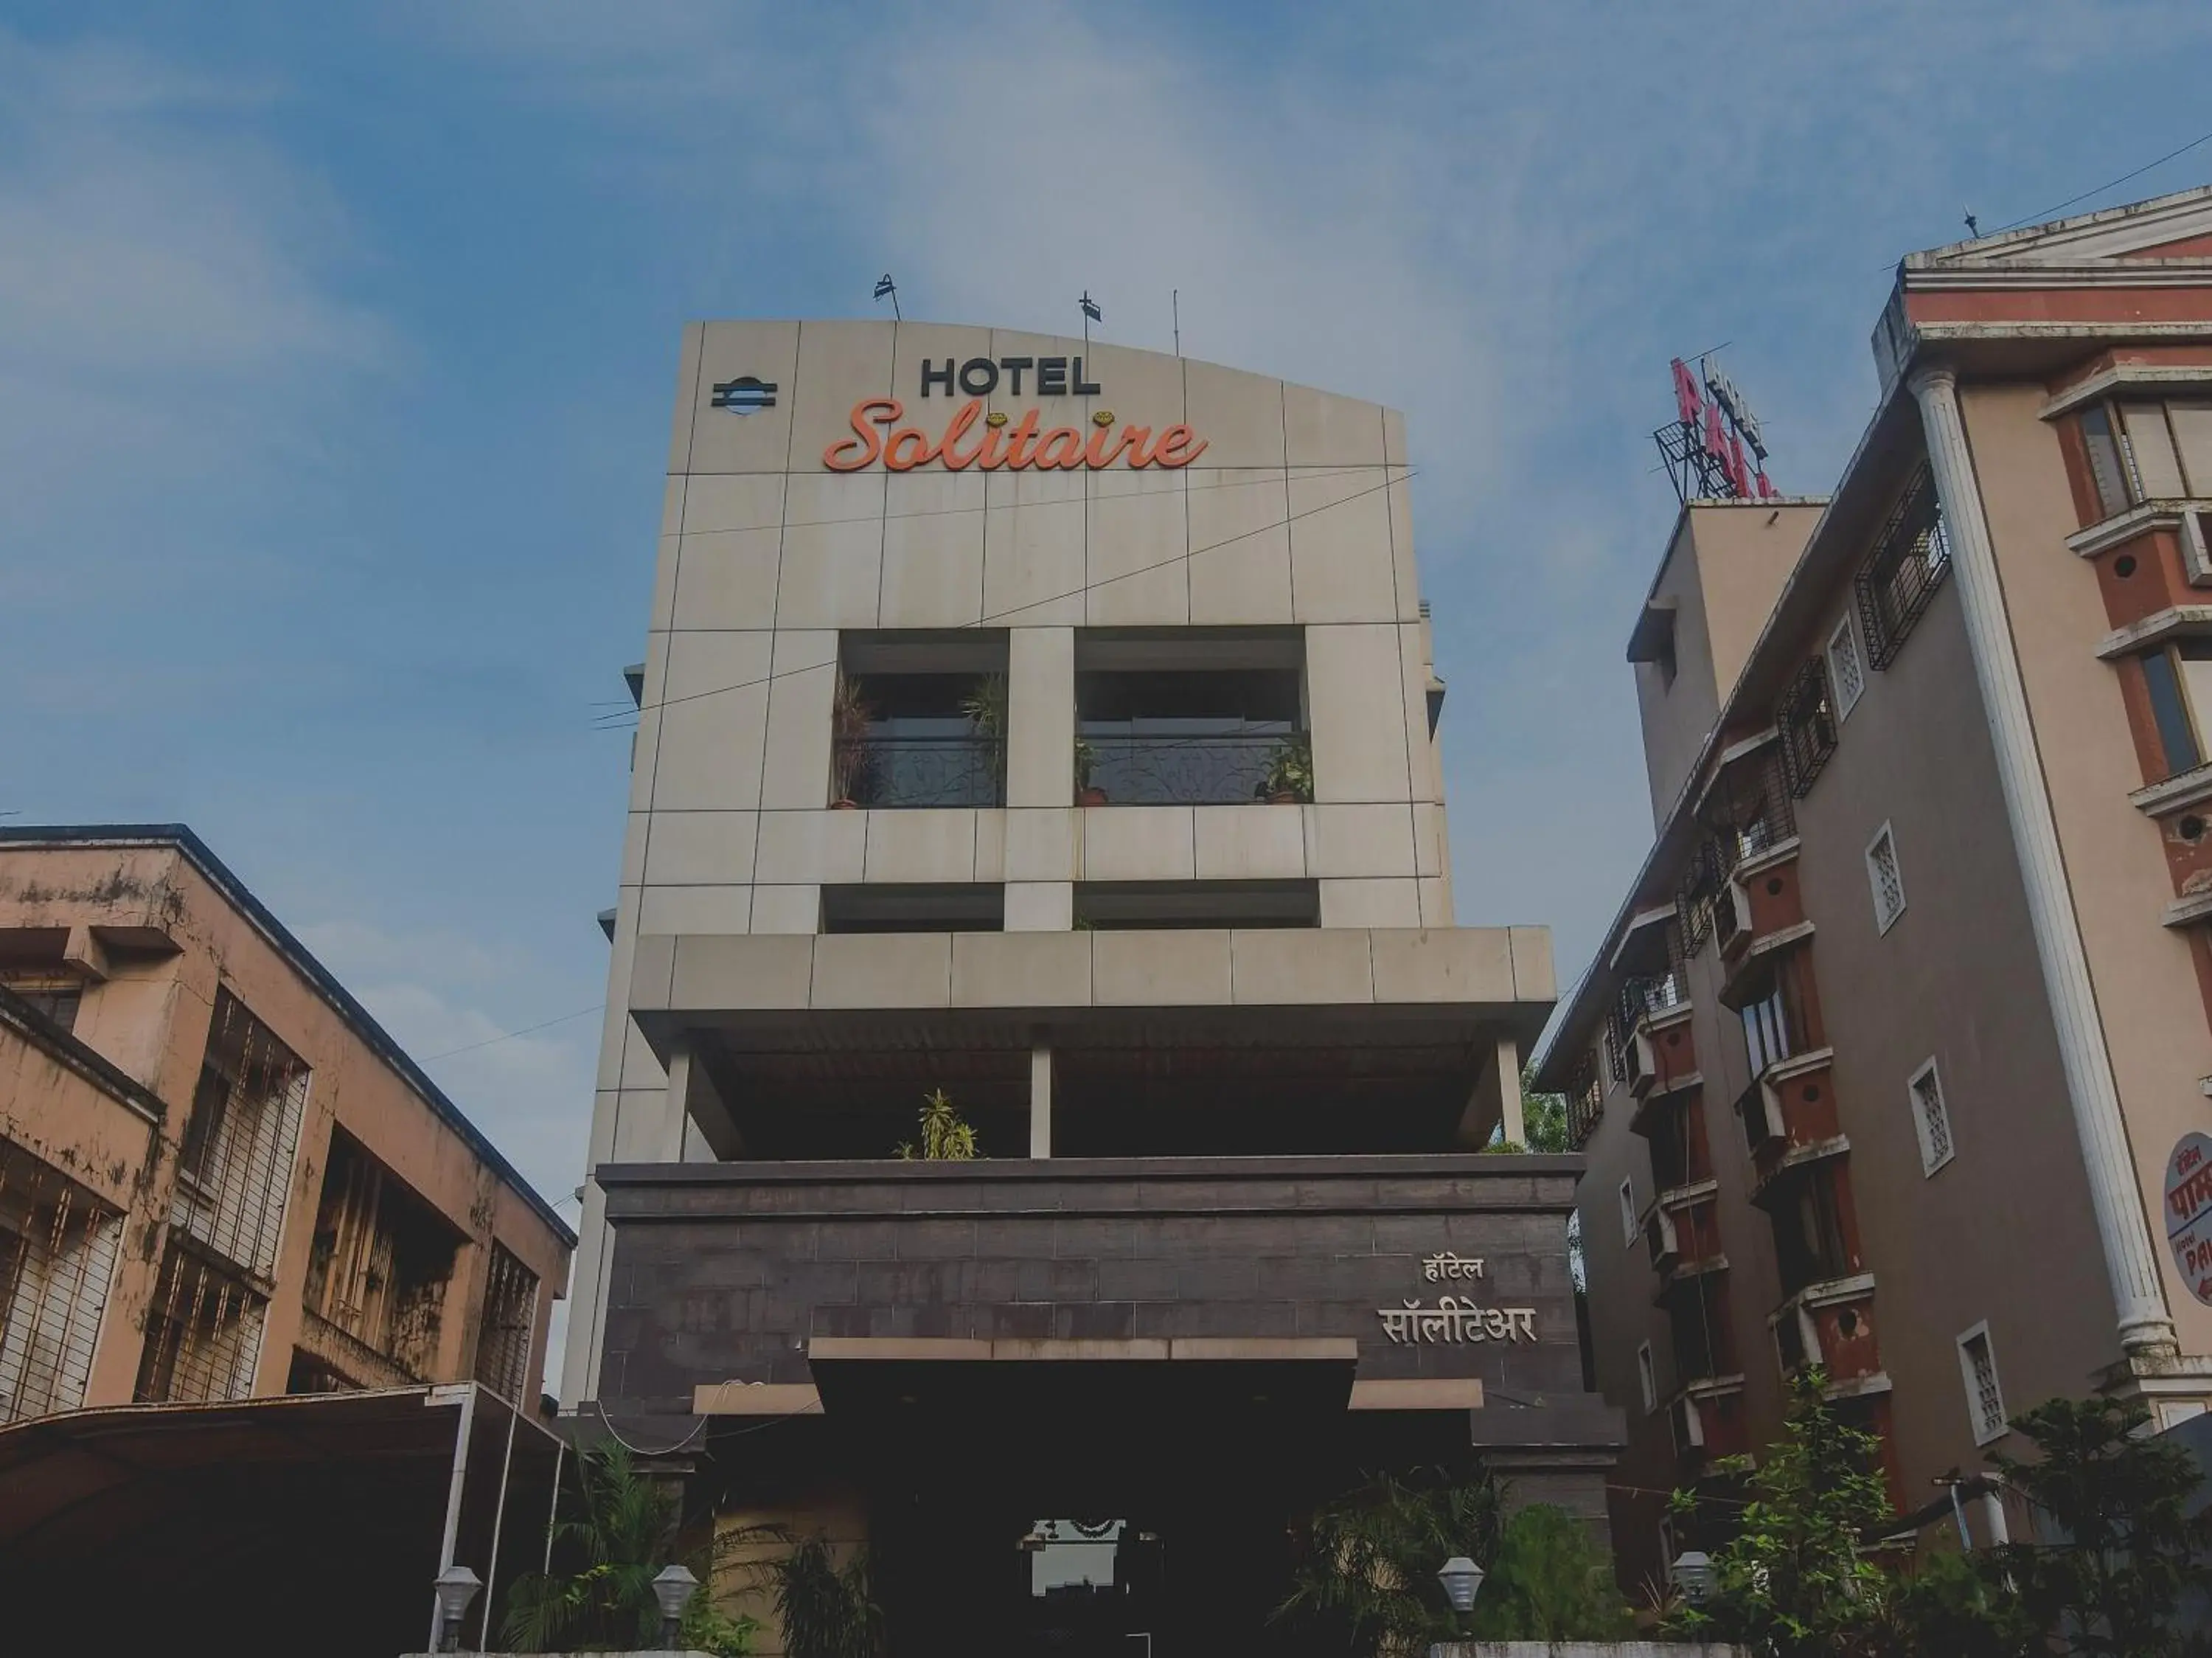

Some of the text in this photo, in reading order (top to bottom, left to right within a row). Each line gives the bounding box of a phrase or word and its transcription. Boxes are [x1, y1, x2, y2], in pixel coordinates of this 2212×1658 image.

[921, 356, 1101, 398] HOTEL
[824, 398, 1208, 471] Solitaire
[1422, 1251, 1484, 1283] हॉटेल
[1377, 1296, 1538, 1344] सॉलीटेअर
